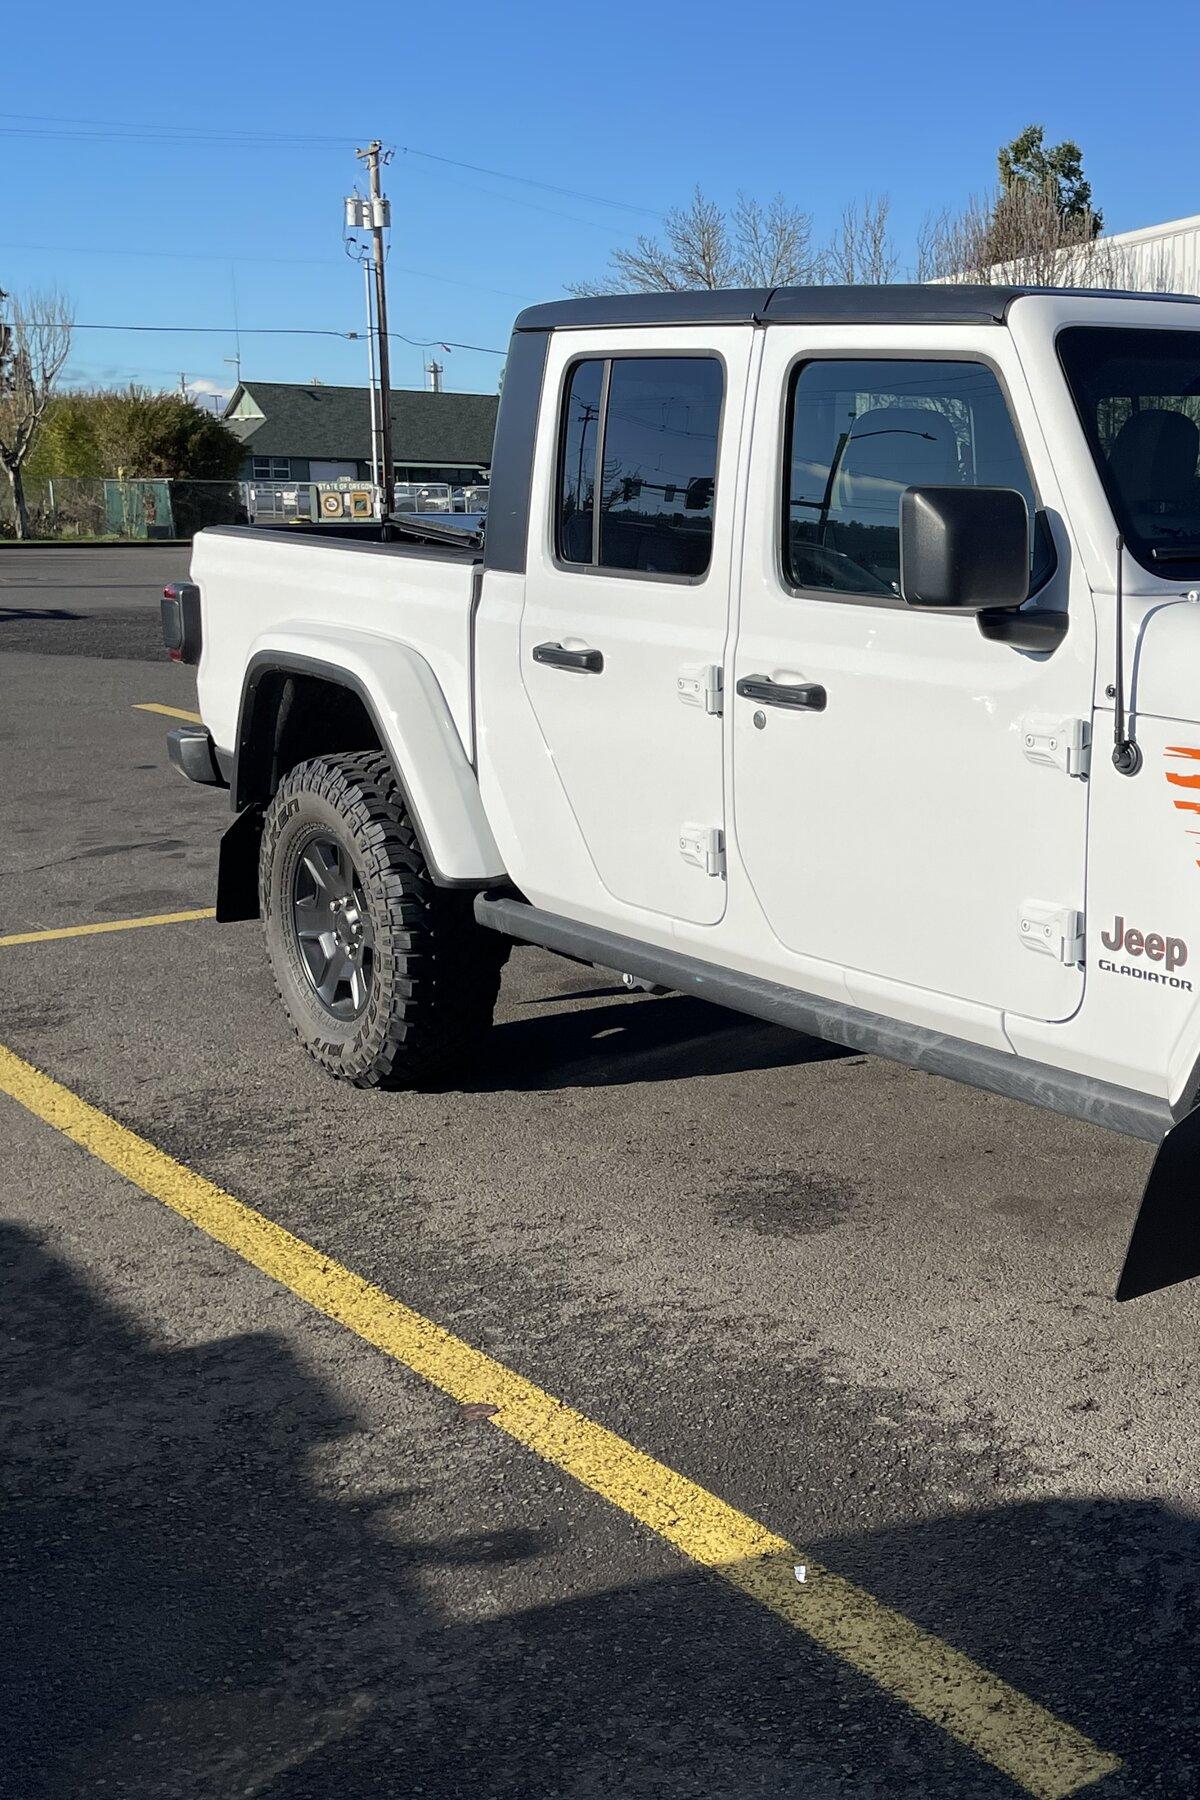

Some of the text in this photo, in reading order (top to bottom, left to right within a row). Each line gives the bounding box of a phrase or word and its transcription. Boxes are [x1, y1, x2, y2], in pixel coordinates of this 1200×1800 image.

[318, 482, 338, 491] STATE
[339, 483, 347, 491] OF
[1101, 915, 1188, 972] Jeep
[1098, 959, 1193, 993] GLADIATOR
